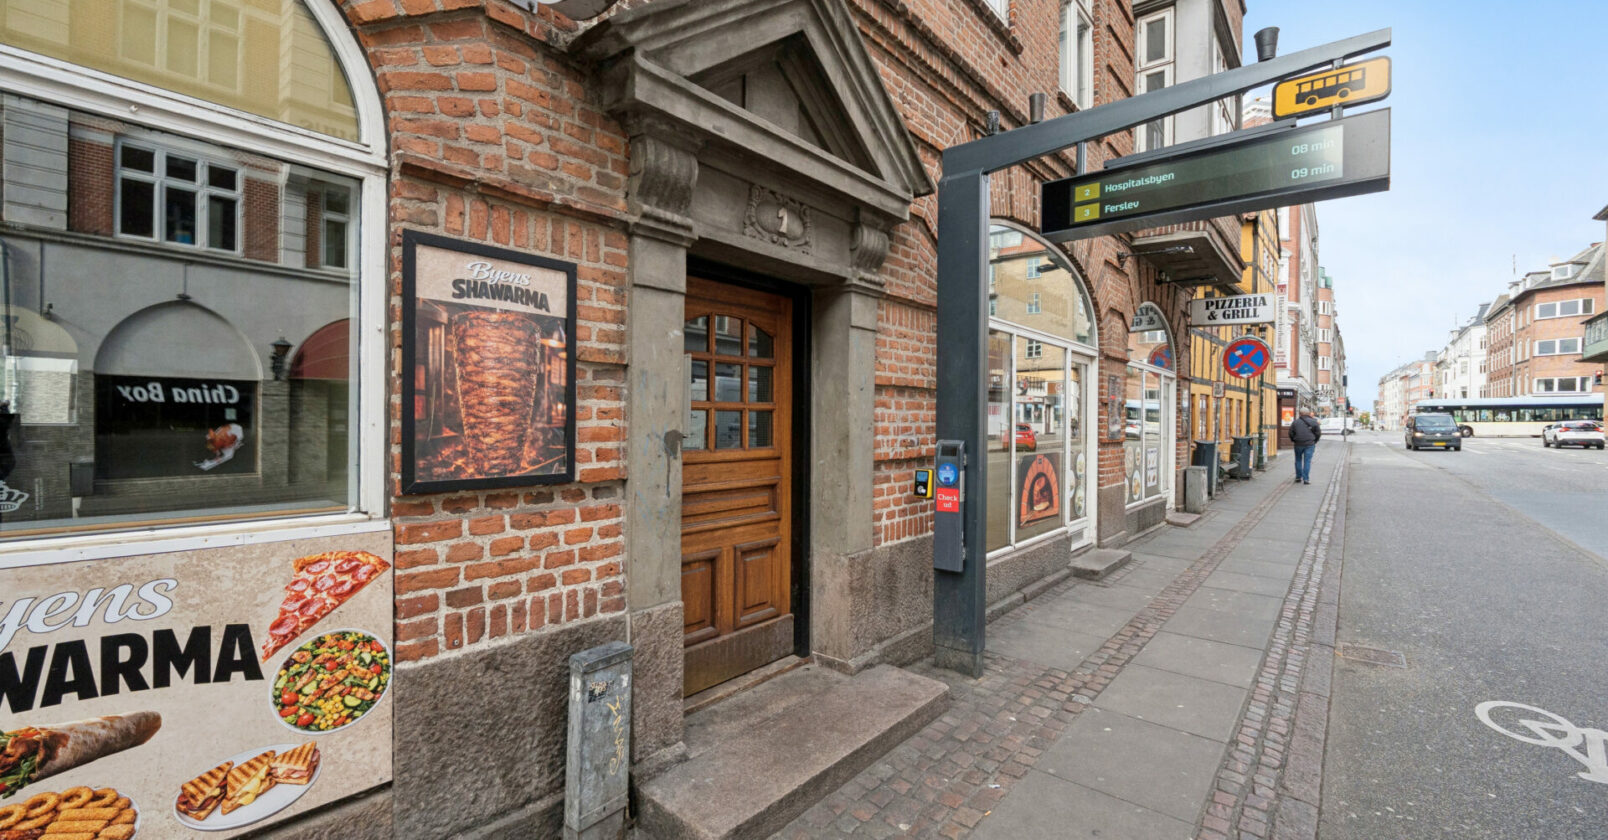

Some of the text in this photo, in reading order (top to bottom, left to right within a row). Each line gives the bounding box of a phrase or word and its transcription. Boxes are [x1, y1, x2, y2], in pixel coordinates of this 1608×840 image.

[1104, 172, 1175, 193] Hospitalsbyen
[1291, 143, 1309, 155] 08
[1311, 139, 1335, 151] min
[1104, 200, 1140, 214] Ferslev
[1291, 167, 1309, 179] 09
[1311, 163, 1335, 176] min
[778, 207, 788, 234] 1
[465, 261, 532, 286] Byens
[451, 278, 551, 313] SHAWARMA
[1205, 296, 1267, 311] PIZZERIA
[1207, 308, 1260, 321] & GRILL
[937, 493, 958, 502] Check
